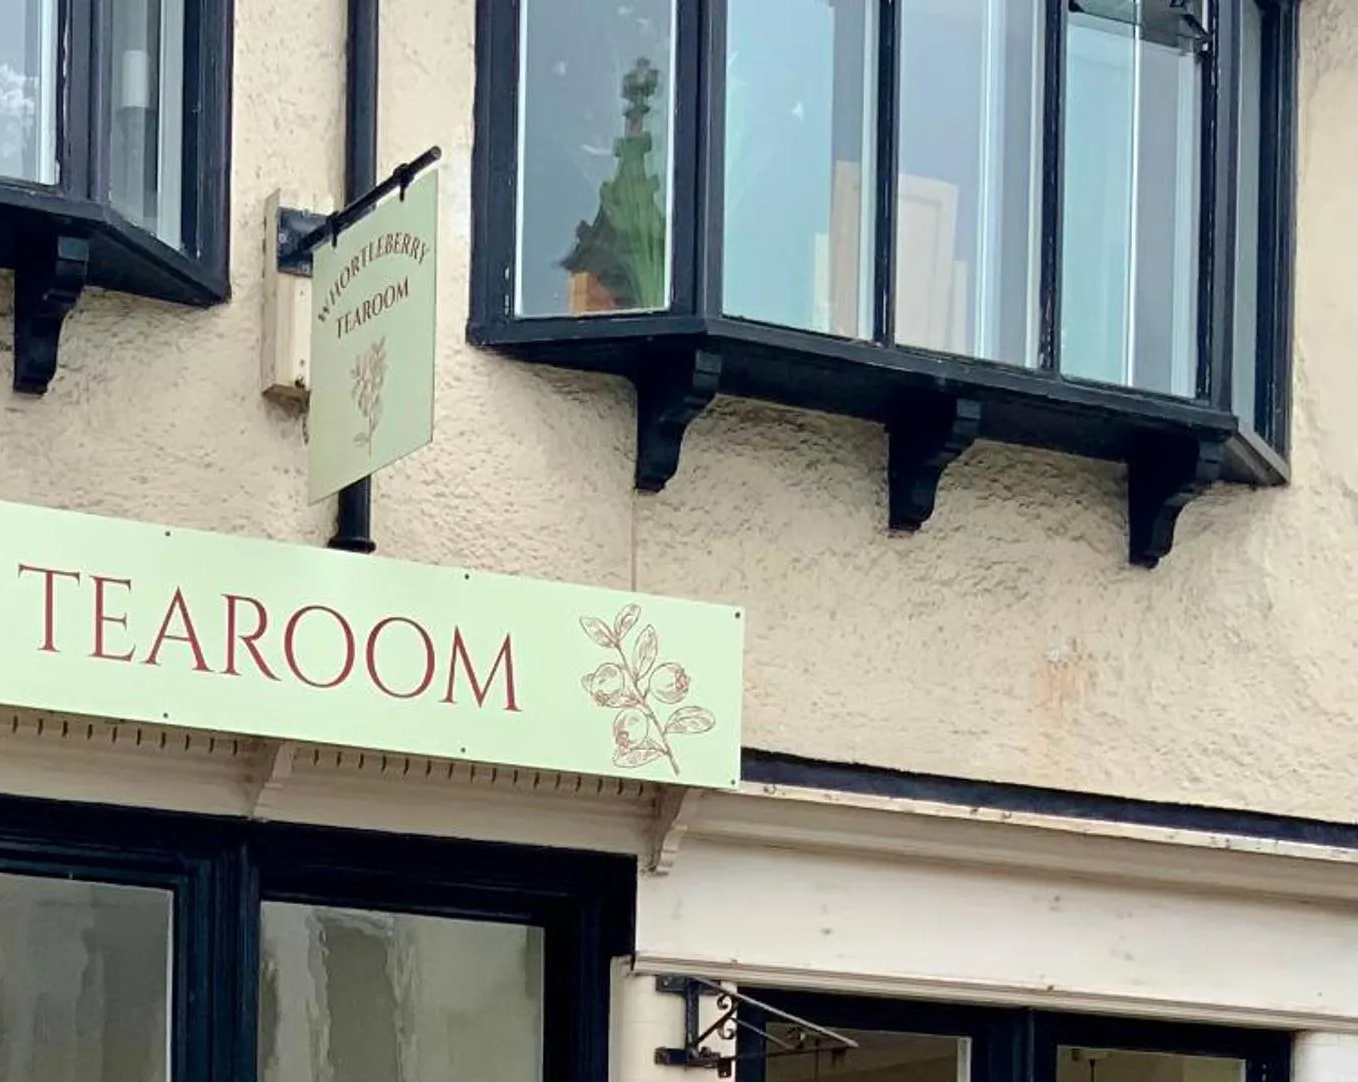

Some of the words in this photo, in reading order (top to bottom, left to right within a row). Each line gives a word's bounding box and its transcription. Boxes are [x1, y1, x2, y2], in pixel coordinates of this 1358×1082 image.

[318, 232, 430, 322] WHORTLEBERRY
[336, 275, 409, 339] TEAROOM
[18, 563, 522, 712] TEAROOM
